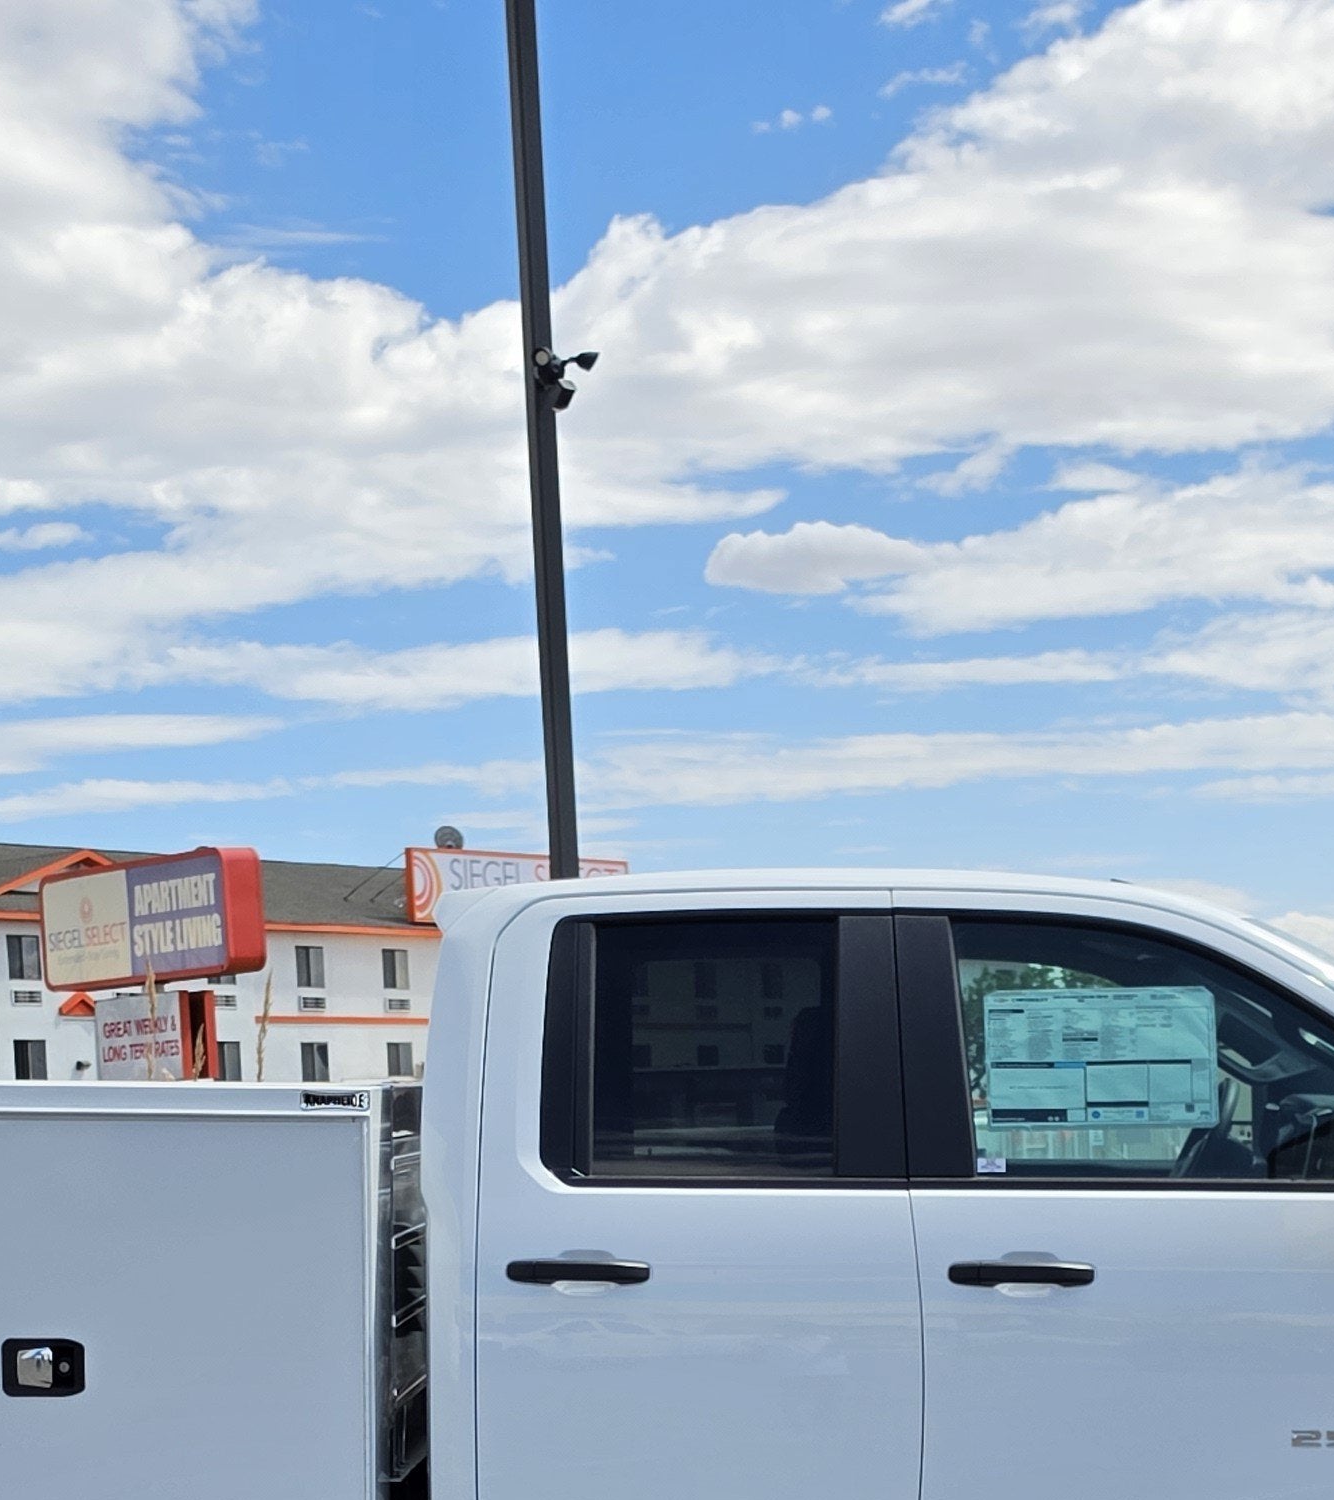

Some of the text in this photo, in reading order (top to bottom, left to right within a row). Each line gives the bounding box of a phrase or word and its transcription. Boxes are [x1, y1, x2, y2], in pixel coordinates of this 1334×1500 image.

[134, 872, 216, 917] APARTMENT
[48, 921, 127, 951] SIEGEL SELECT
[133, 919, 175, 957] STYLE
[175, 913, 222, 950] LIVING
[103, 1020, 132, 1039] GREAT
[170, 1015, 177, 1032] &
[102, 1039, 180, 1063] LONG TER RATES
